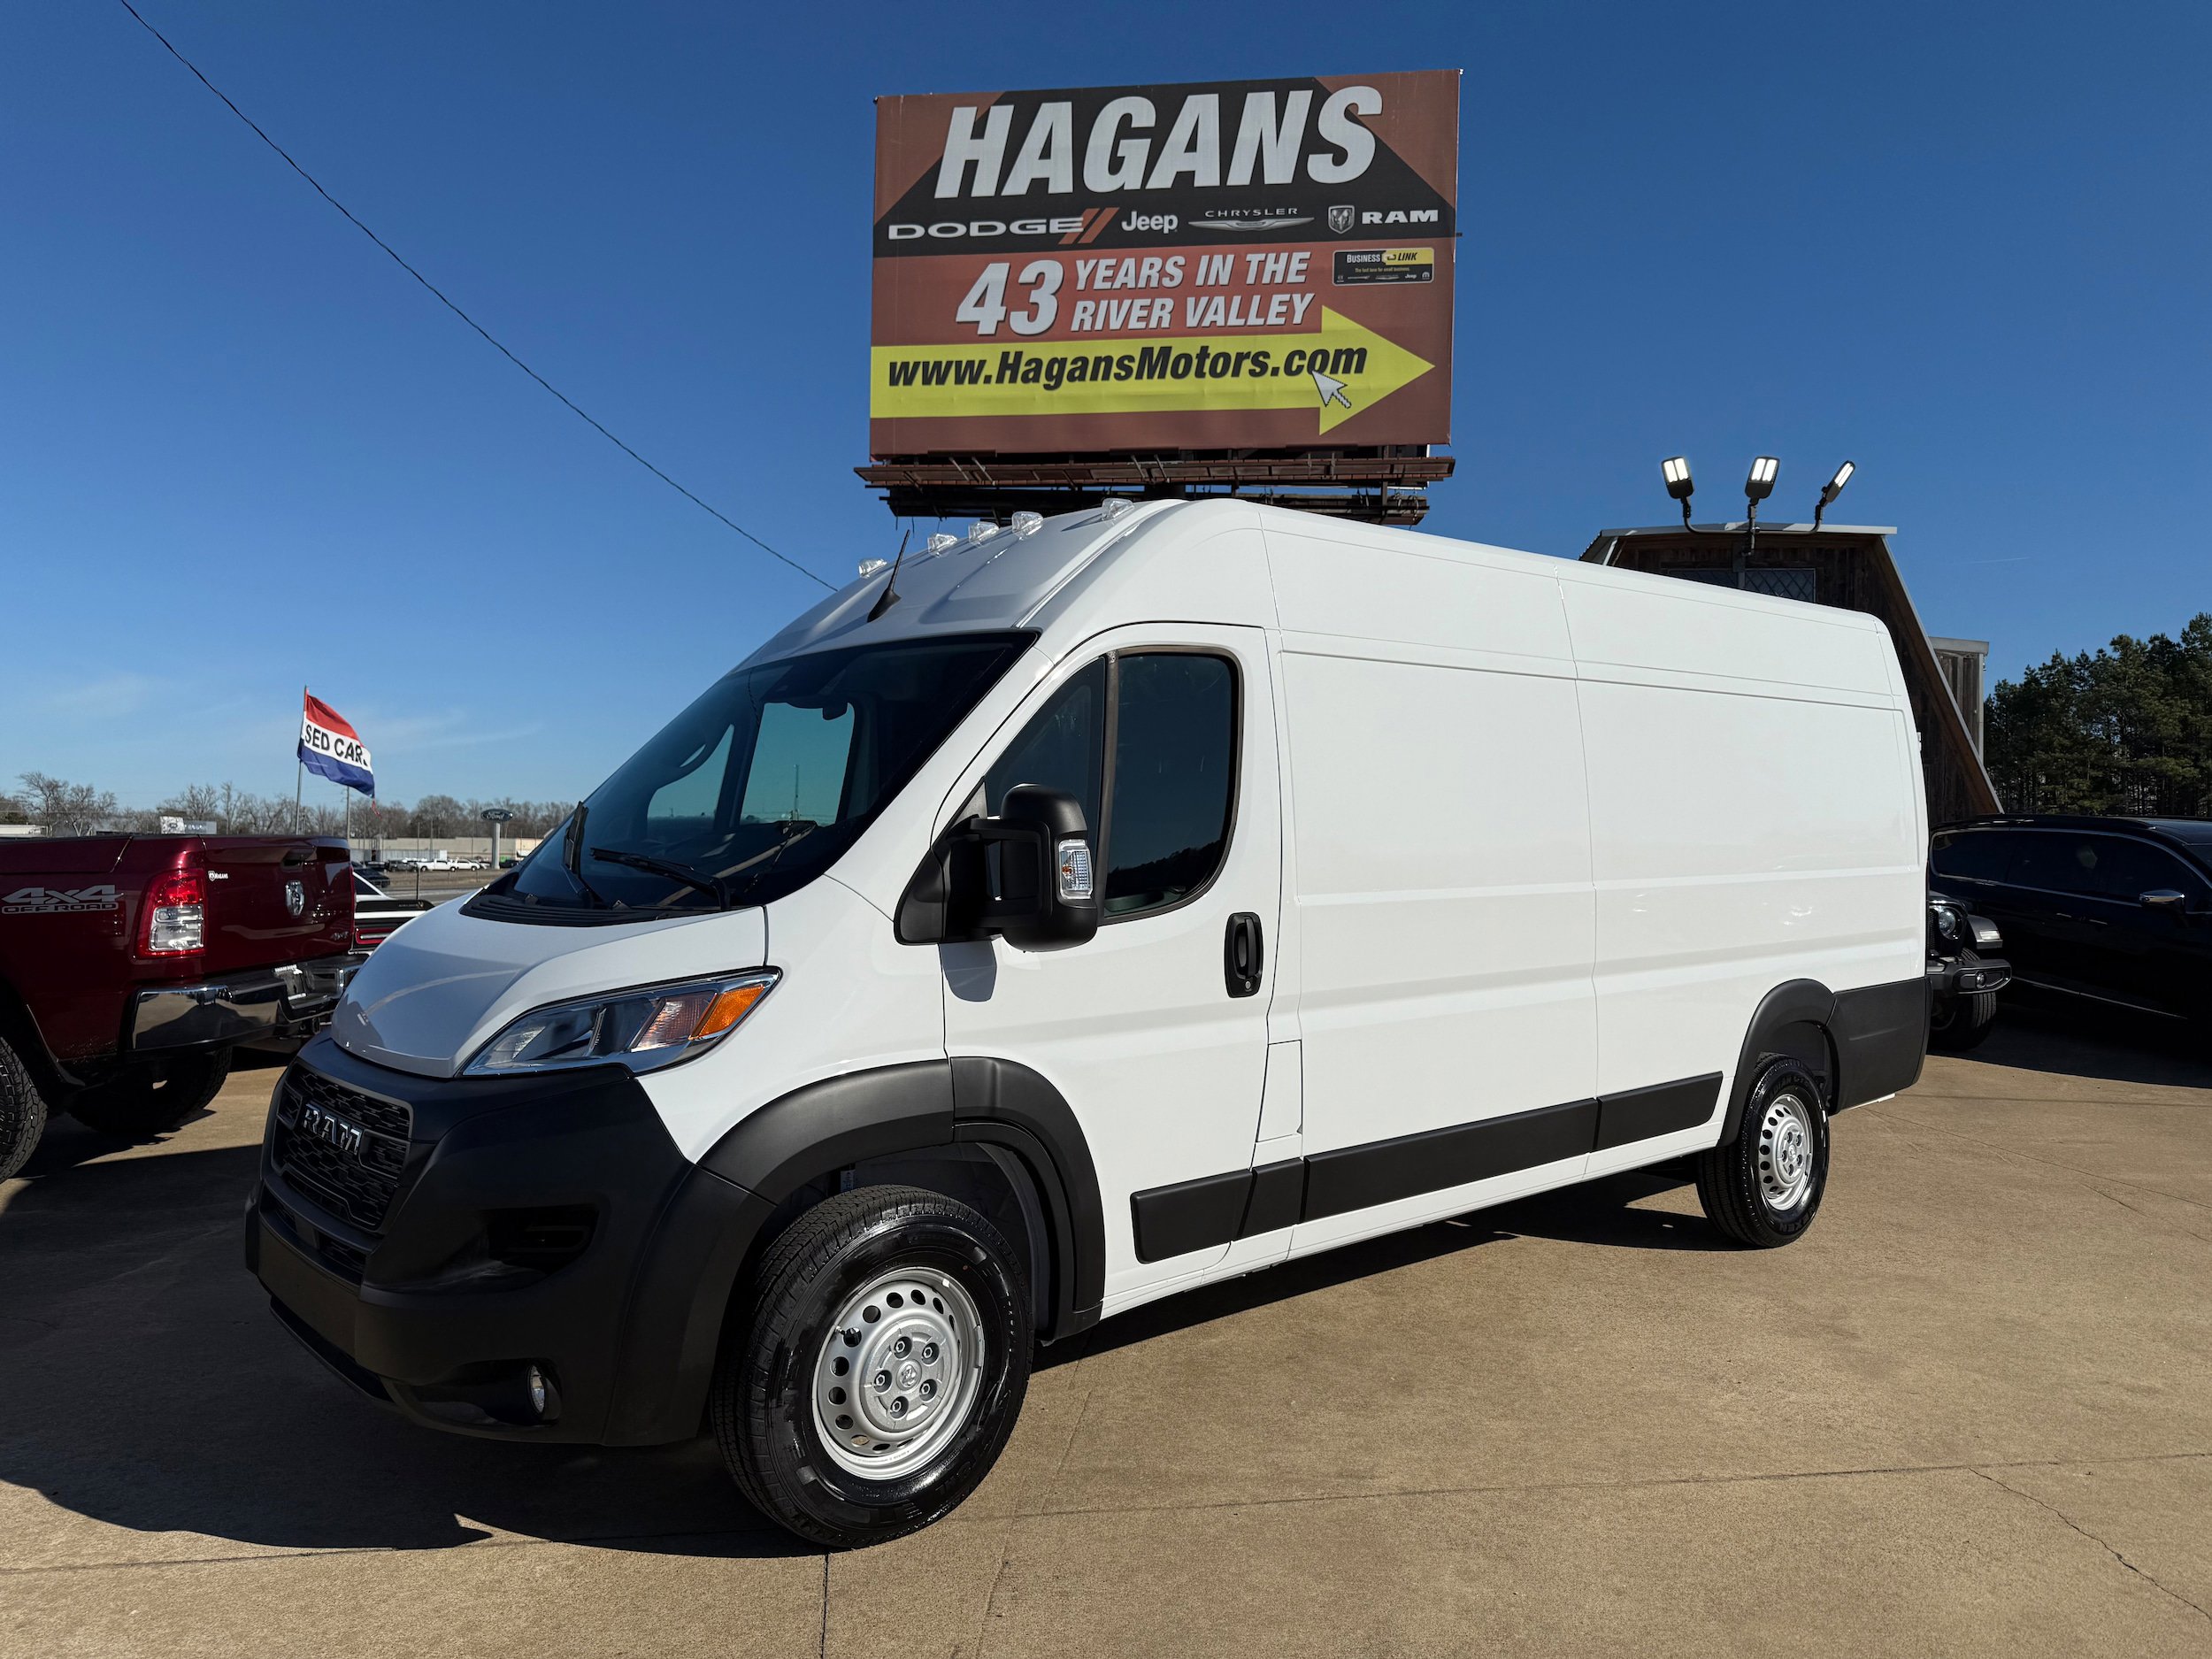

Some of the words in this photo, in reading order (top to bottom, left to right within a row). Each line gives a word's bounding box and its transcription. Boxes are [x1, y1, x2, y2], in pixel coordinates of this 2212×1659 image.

[934, 86, 1382, 198] HAGANS
[888, 217, 1084, 240] DODGE
[1121, 211, 1179, 234] Jeep
[1205, 208, 1298, 218] CHRYSLER
[1362, 210, 1439, 224] RAM
[1075, 255, 1186, 291] YEARS
[1195, 255, 1234, 287] IN
[1245, 252, 1311, 285] THE
[1397, 252, 1417, 261] LINK
[956, 259, 1064, 335] 43
[1071, 297, 1174, 332] RIVER
[1186, 293, 1315, 327] VALLEY
[888, 346, 1367, 390] www.HagansMotors.com
[305, 724, 330, 751] SED
[334, 738, 368, 767] CAR
[54, 902, 117, 911] ROAD
[303, 1103, 364, 1156] RAM
